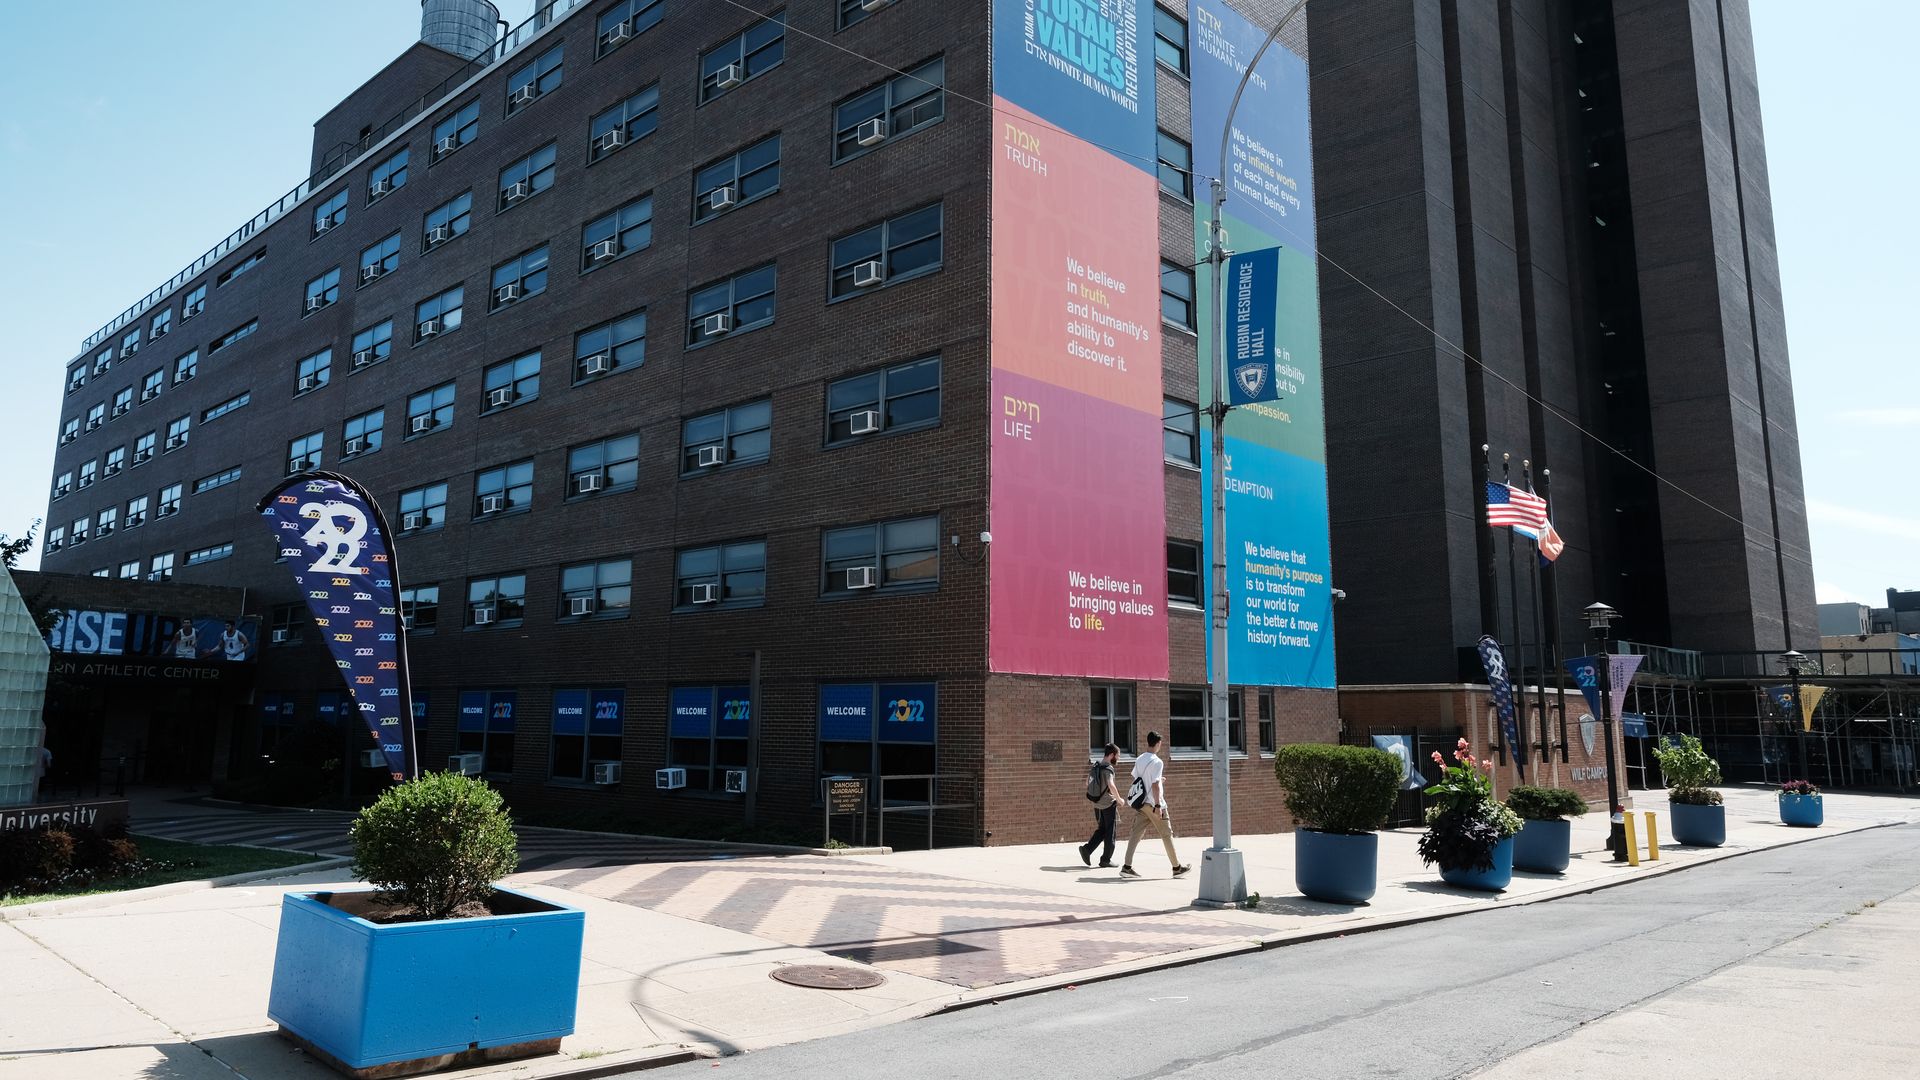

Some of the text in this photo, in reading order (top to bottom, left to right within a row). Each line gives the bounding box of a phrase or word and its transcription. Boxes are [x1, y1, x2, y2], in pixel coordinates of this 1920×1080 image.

[1025, 12, 1034, 40] ADAM
[1036, 10, 1124, 90] VALUES
[1116, 28, 1124, 59] ZION
[1198, 24, 1235, 57] INFINITE
[1198, 36, 1232, 68] HUMAN
[1124, 10, 1138, 99] REDEMPTION
[1048, 52, 1138, 114] INFINITE HUMAN WORTH
[1004, 123, 1040, 155] אמת
[1232, 127, 1283, 167] We believe in
[1004, 144, 1047, 176] TRUTH
[1232, 144, 1297, 191] the infinite worth
[1233, 163, 1301, 210] of each and every
[1234, 176, 1287, 216] human being.
[1066, 257, 1126, 293] We believe
[1067, 278, 1110, 309] in truth,
[1067, 302, 1149, 340] and humanity's
[1238, 262, 1253, 359] RUBIN RESIDENCE
[1067, 321, 1114, 348] ability to
[1252, 327, 1265, 357] HALL
[1067, 340, 1127, 372] discover it.
[1283, 348, 1290, 361] in
[1275, 363, 1305, 385] nsibility
[1289, 383, 1297, 394] to
[1004, 395, 1040, 423] חיים
[1004, 419, 1032, 440] LIFE
[1224, 477, 1273, 500] DEMPTION
[1244, 541, 1306, 565] We believe that
[1069, 570, 1142, 595] We believe in
[1245, 559, 1323, 584] humanity's purpose
[1245, 576, 1305, 597] is to transform
[1069, 591, 1154, 616] bringing values
[1246, 597, 1300, 613] our world for
[1069, 613, 1105, 631] to life.
[1246, 611, 1319, 632] the better & move
[1247, 629, 1311, 648] history forward.
[82, 663, 156, 677] ATHLETIC
[164, 666, 220, 680] CENTER
[493, 702, 512, 719] 2022
[558, 707, 583, 715] WELCOME
[595, 701, 618, 719] 2022
[676, 707, 707, 715] WELCOME
[827, 707, 866, 716] WELCOME
[888, 699, 925, 722] 2022
[1586, 767, 1608, 780] CAMPU
